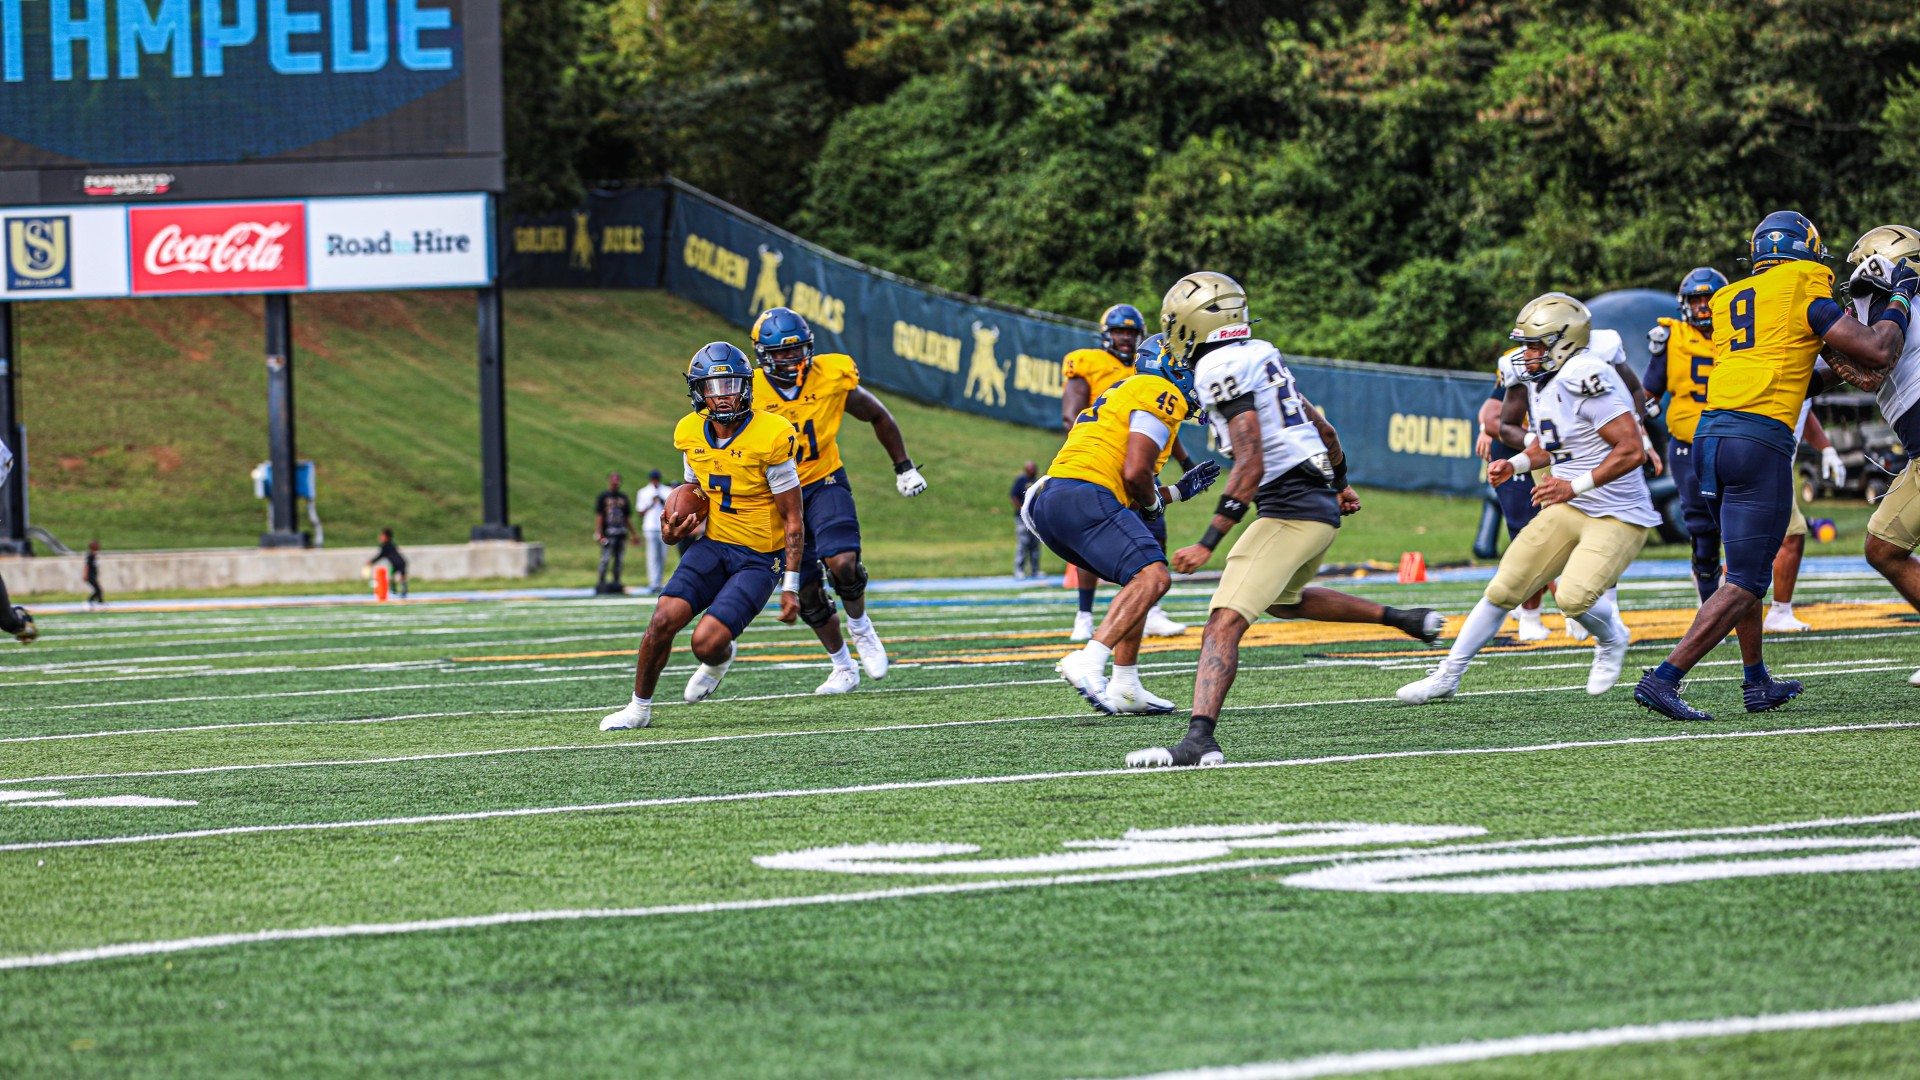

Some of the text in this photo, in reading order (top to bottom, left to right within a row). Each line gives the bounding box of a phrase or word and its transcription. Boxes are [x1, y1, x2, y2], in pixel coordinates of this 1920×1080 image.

[144, 221, 291, 275] Coca-Cola
[325, 231, 392, 256] Road
[413, 228, 471, 254] Hire
[684, 233, 749, 290] GOLDEN
[1729, 287, 1757, 352] 9
[893, 320, 1064, 398] GOLDEN BULL
[1156, 391, 1179, 415] 45
[1210, 375, 1241, 403] 22
[1581, 374, 1604, 396] 42
[788, 435, 795, 458] 7
[1389, 412, 1472, 458] GOLDEN
[709, 474, 738, 514] 7
